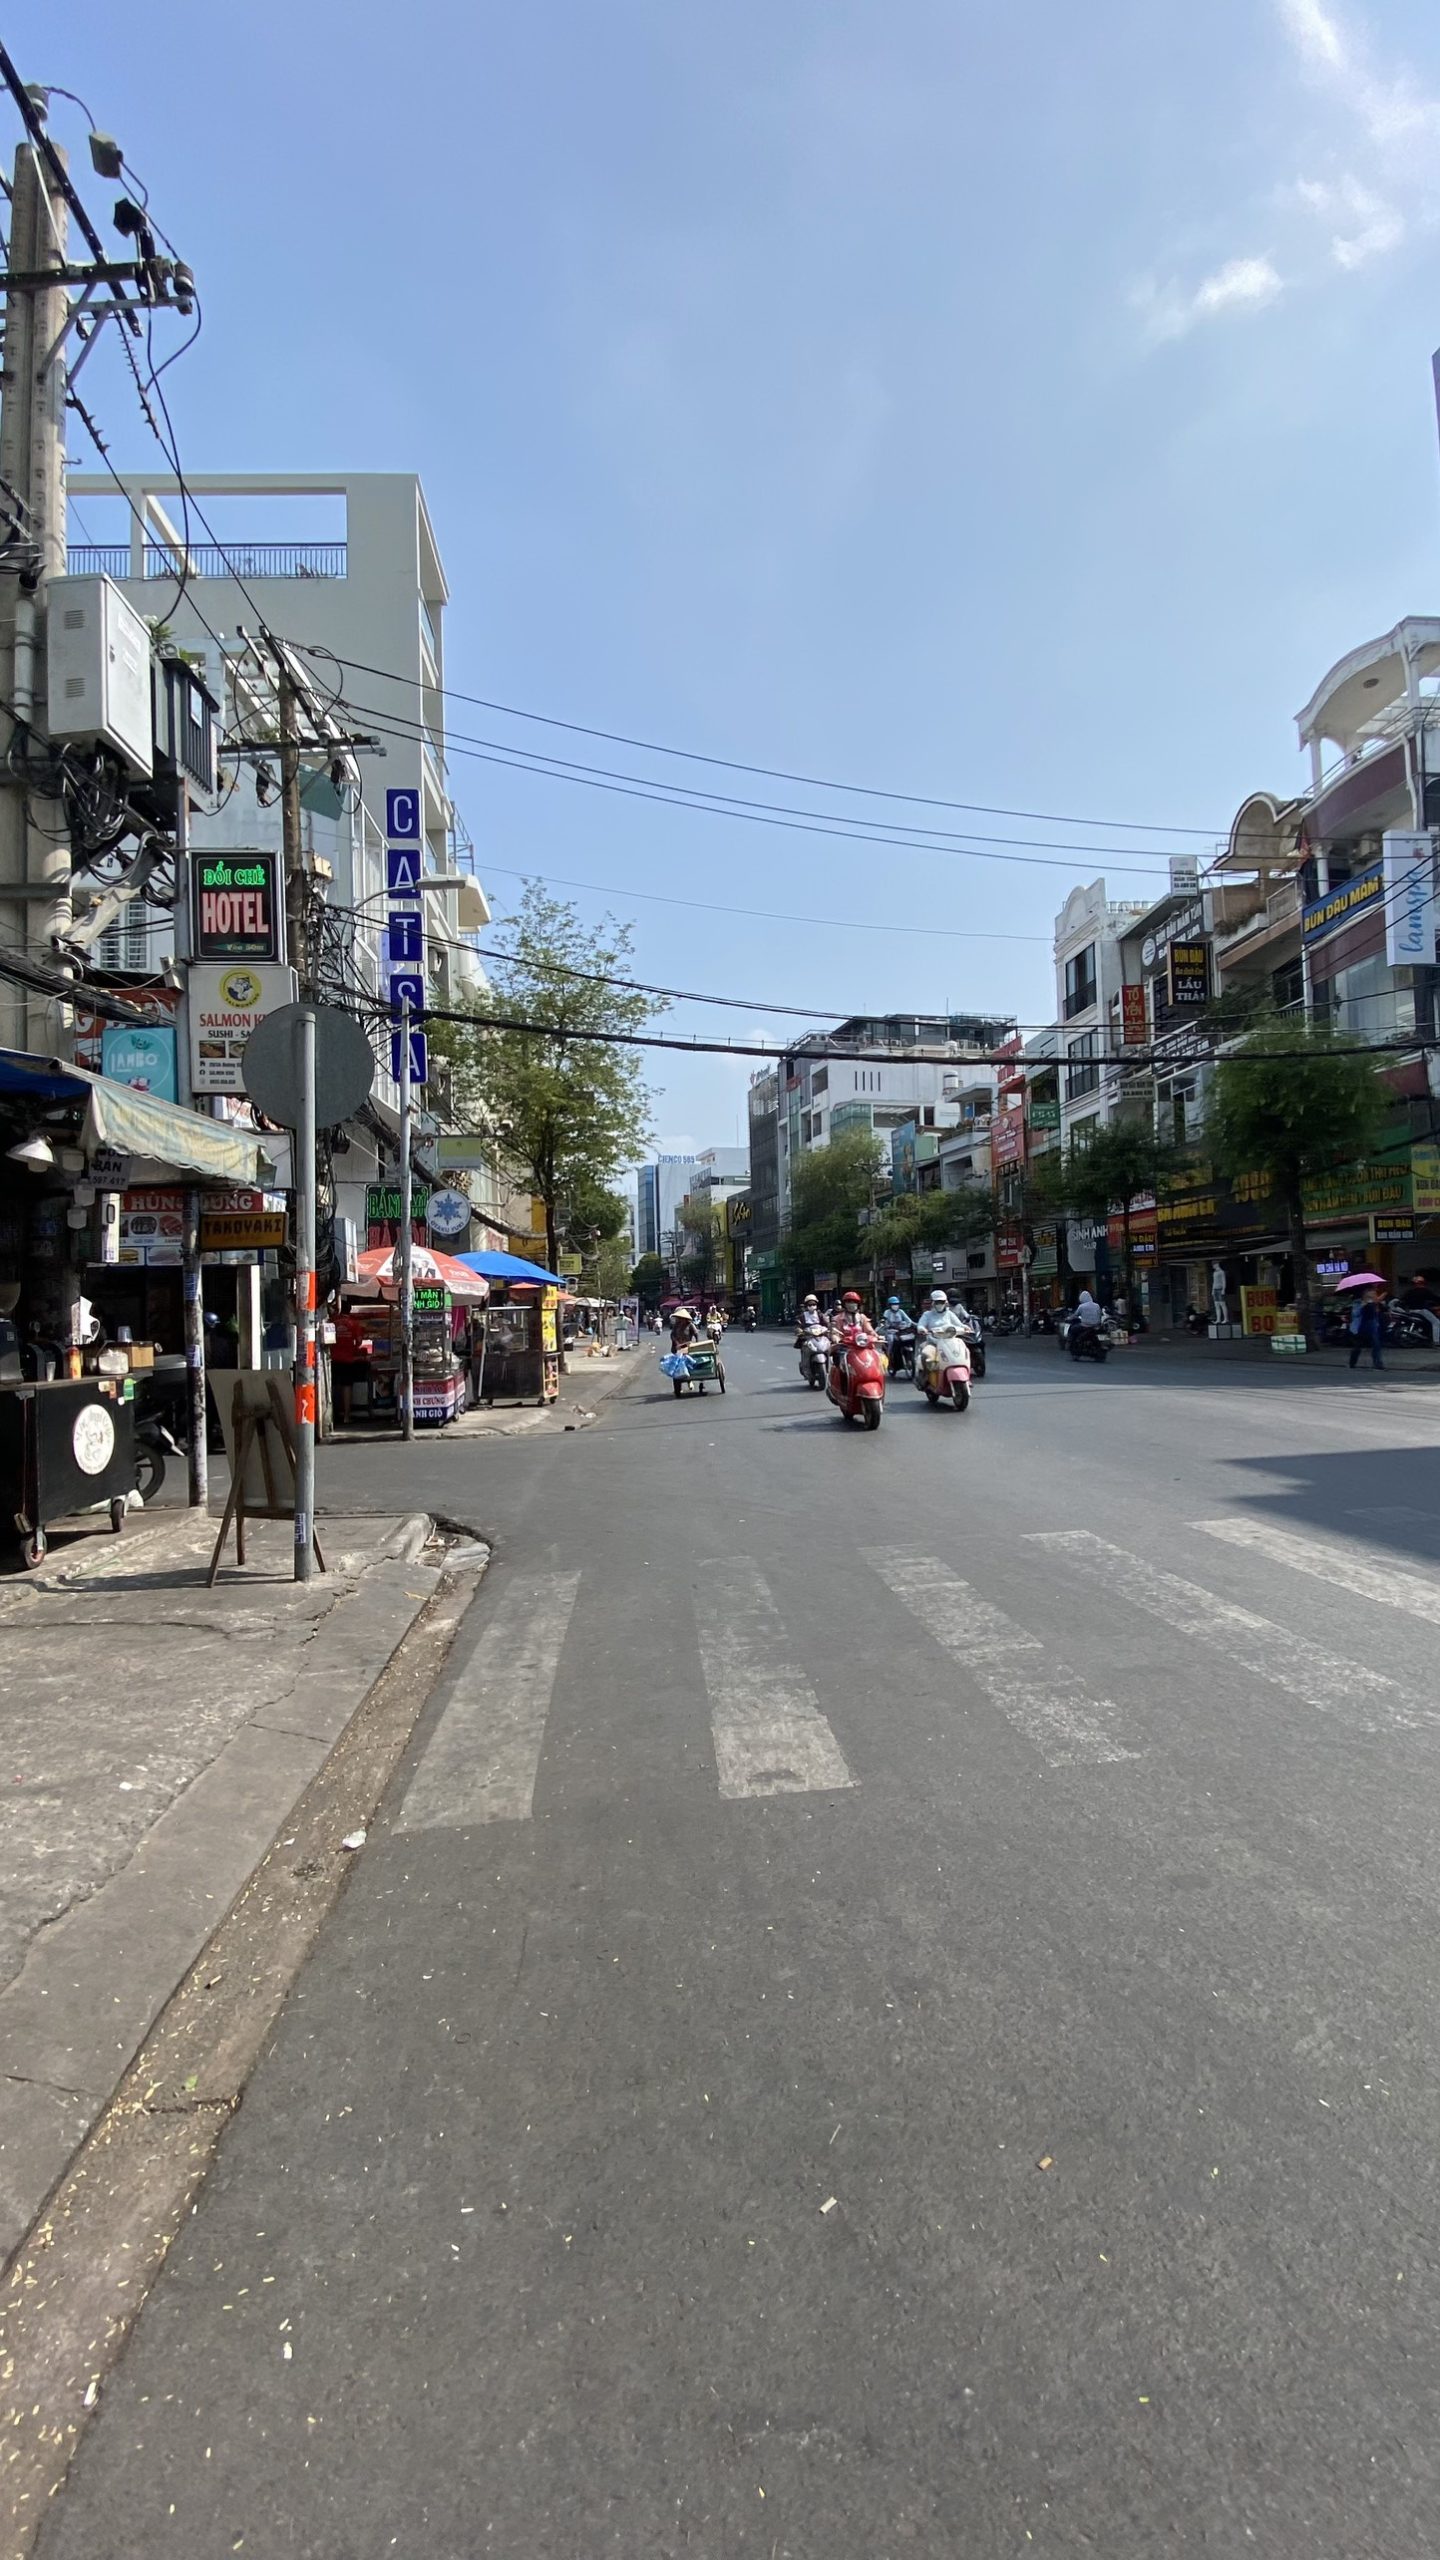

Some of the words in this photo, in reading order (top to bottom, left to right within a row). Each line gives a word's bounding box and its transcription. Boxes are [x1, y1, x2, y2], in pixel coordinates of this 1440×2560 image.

[202, 892, 269, 934] HOTEL
[1303, 909, 1326, 933] BÚN
[199, 1013, 251, 1027] SALMON
[208, 1030, 233, 1039] SUSHI
[657, 1154, 682, 1164] CIENCO
[204, 1217, 282, 1235] TAKOYAKI
[1071, 1227, 1091, 1240] SINH
[1091, 1224, 1109, 1238] ANH
